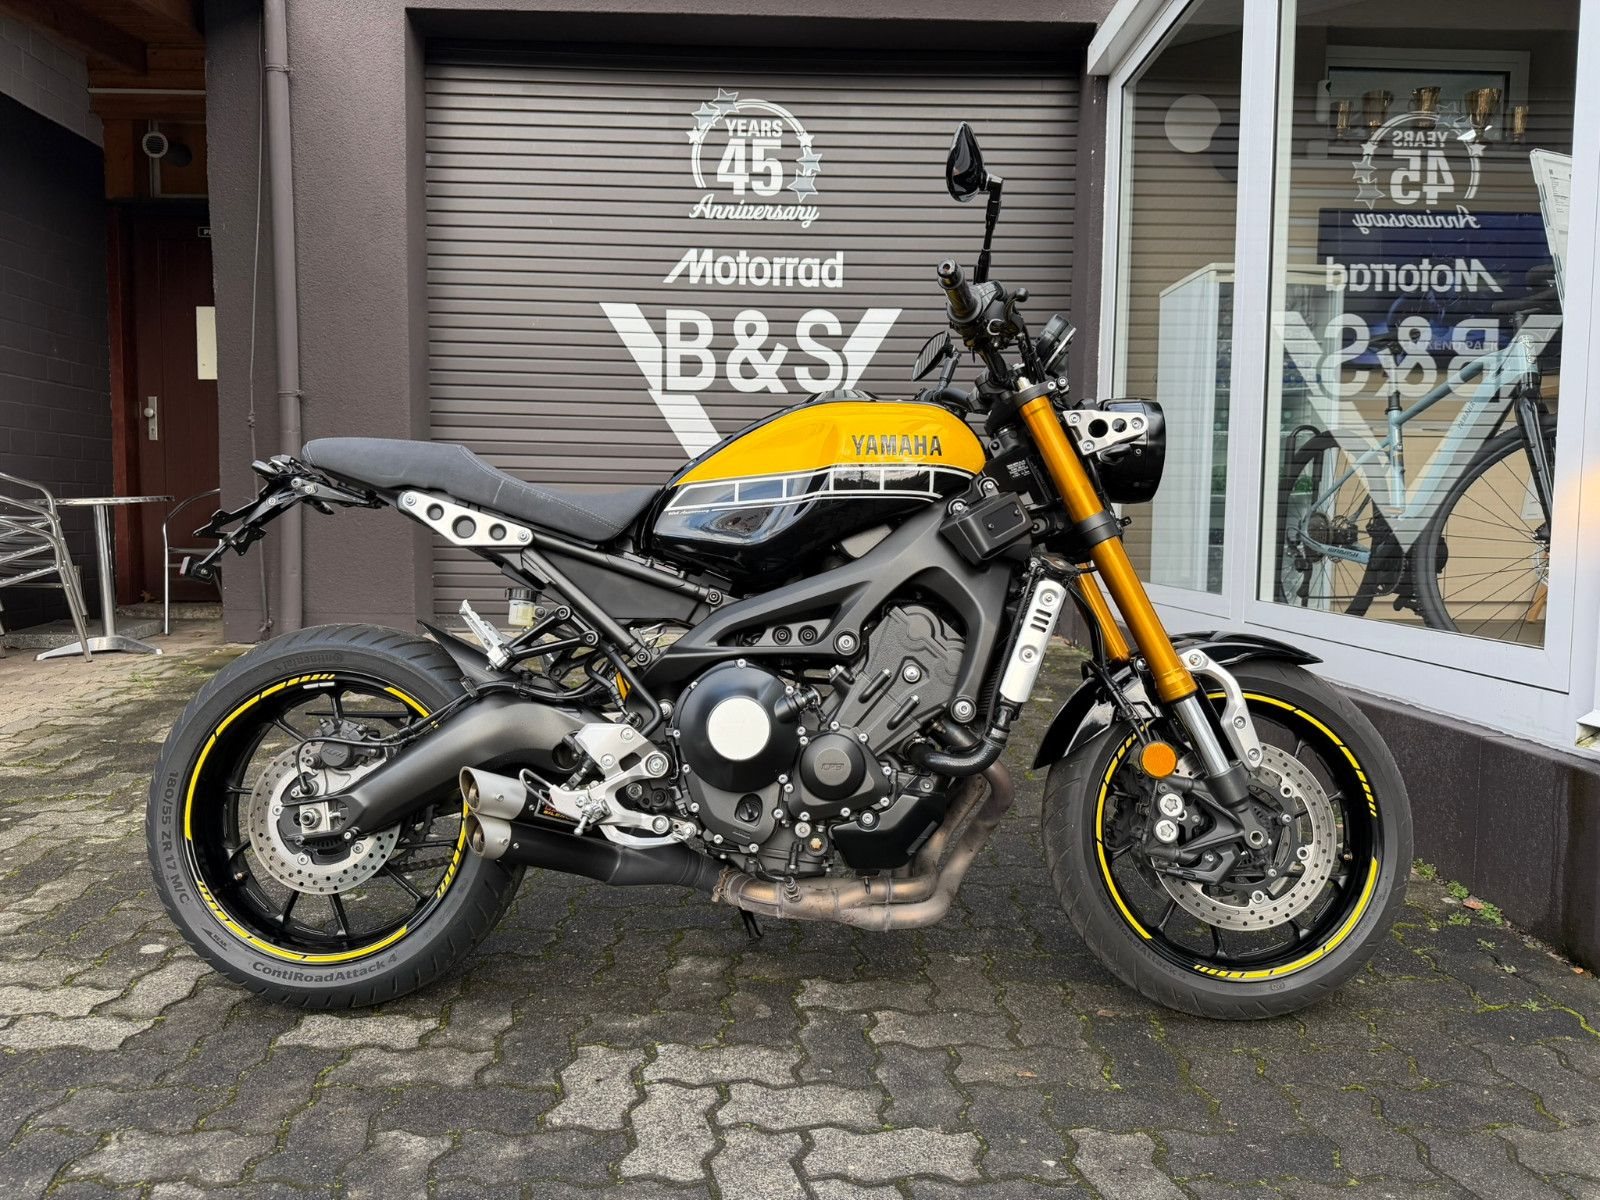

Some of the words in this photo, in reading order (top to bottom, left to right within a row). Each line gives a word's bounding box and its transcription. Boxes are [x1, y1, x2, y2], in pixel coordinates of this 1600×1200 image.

[725, 119, 783, 137] YEARS
[717, 138, 783, 196] 45
[689, 193, 820, 228] Anniversary
[663, 248, 844, 288] Motorrad
[665, 308, 843, 393] B&S
[851, 434, 942, 457] YAMAHA
[161, 771, 178, 825] 180/55
[161, 830, 173, 853] ZR
[165, 855, 177, 871] 17
[170, 873, 190, 904] M/C
[252, 960, 386, 983] ContiRoadAttack
[387, 953, 399, 965] 4
